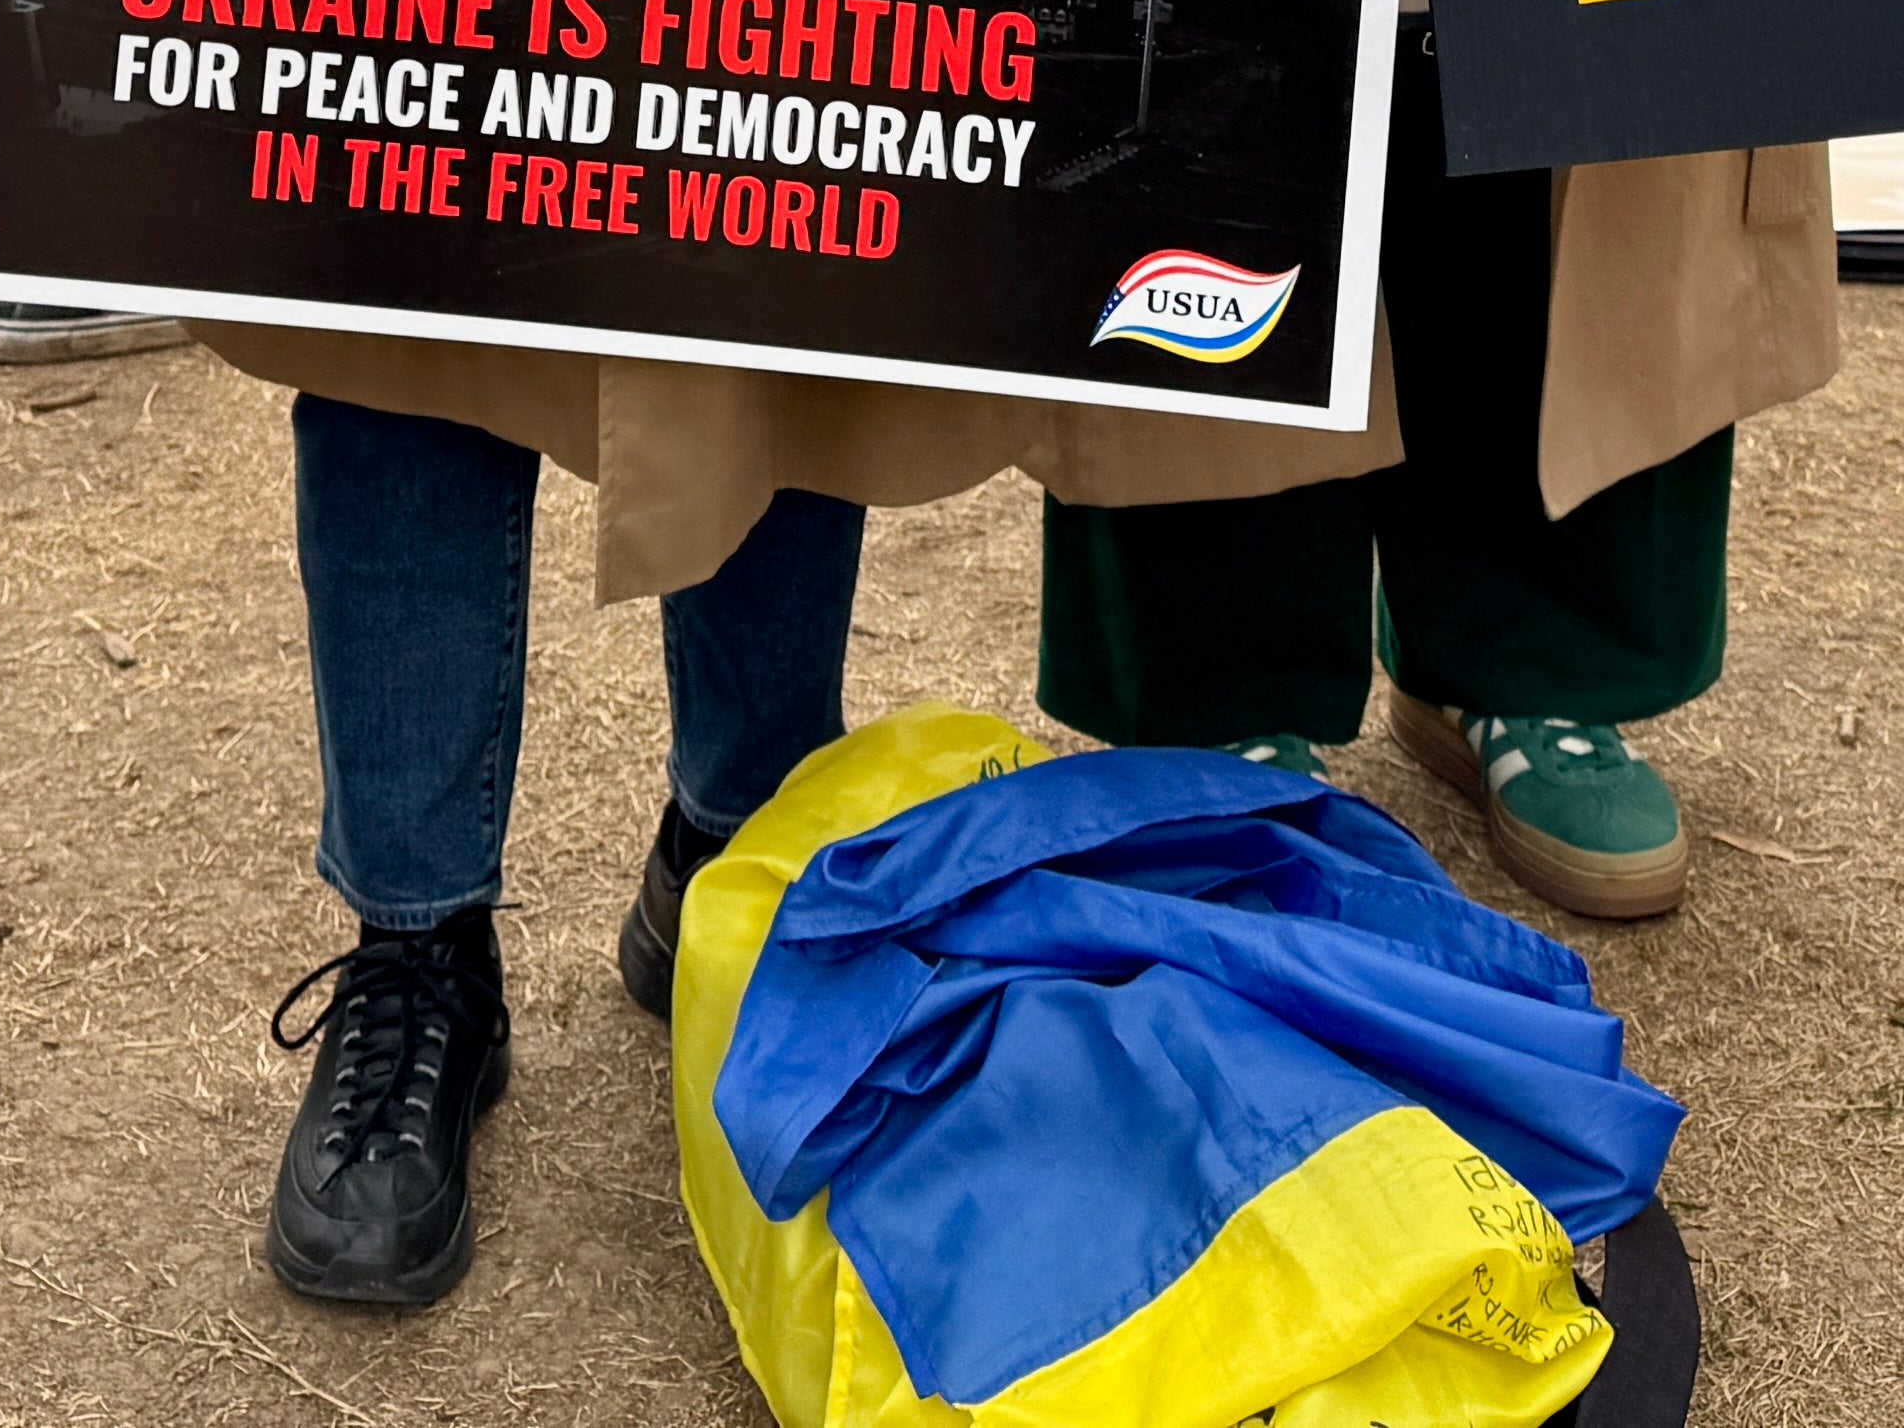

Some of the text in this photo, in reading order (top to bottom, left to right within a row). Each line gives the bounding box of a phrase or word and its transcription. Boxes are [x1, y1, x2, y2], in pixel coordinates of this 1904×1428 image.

[113, 33, 1036, 188] FOR PEACE AND DEMOCRACY
[250, 130, 901, 260] IN THE FREE WORLD
[1146, 287, 1245, 324] USUA
